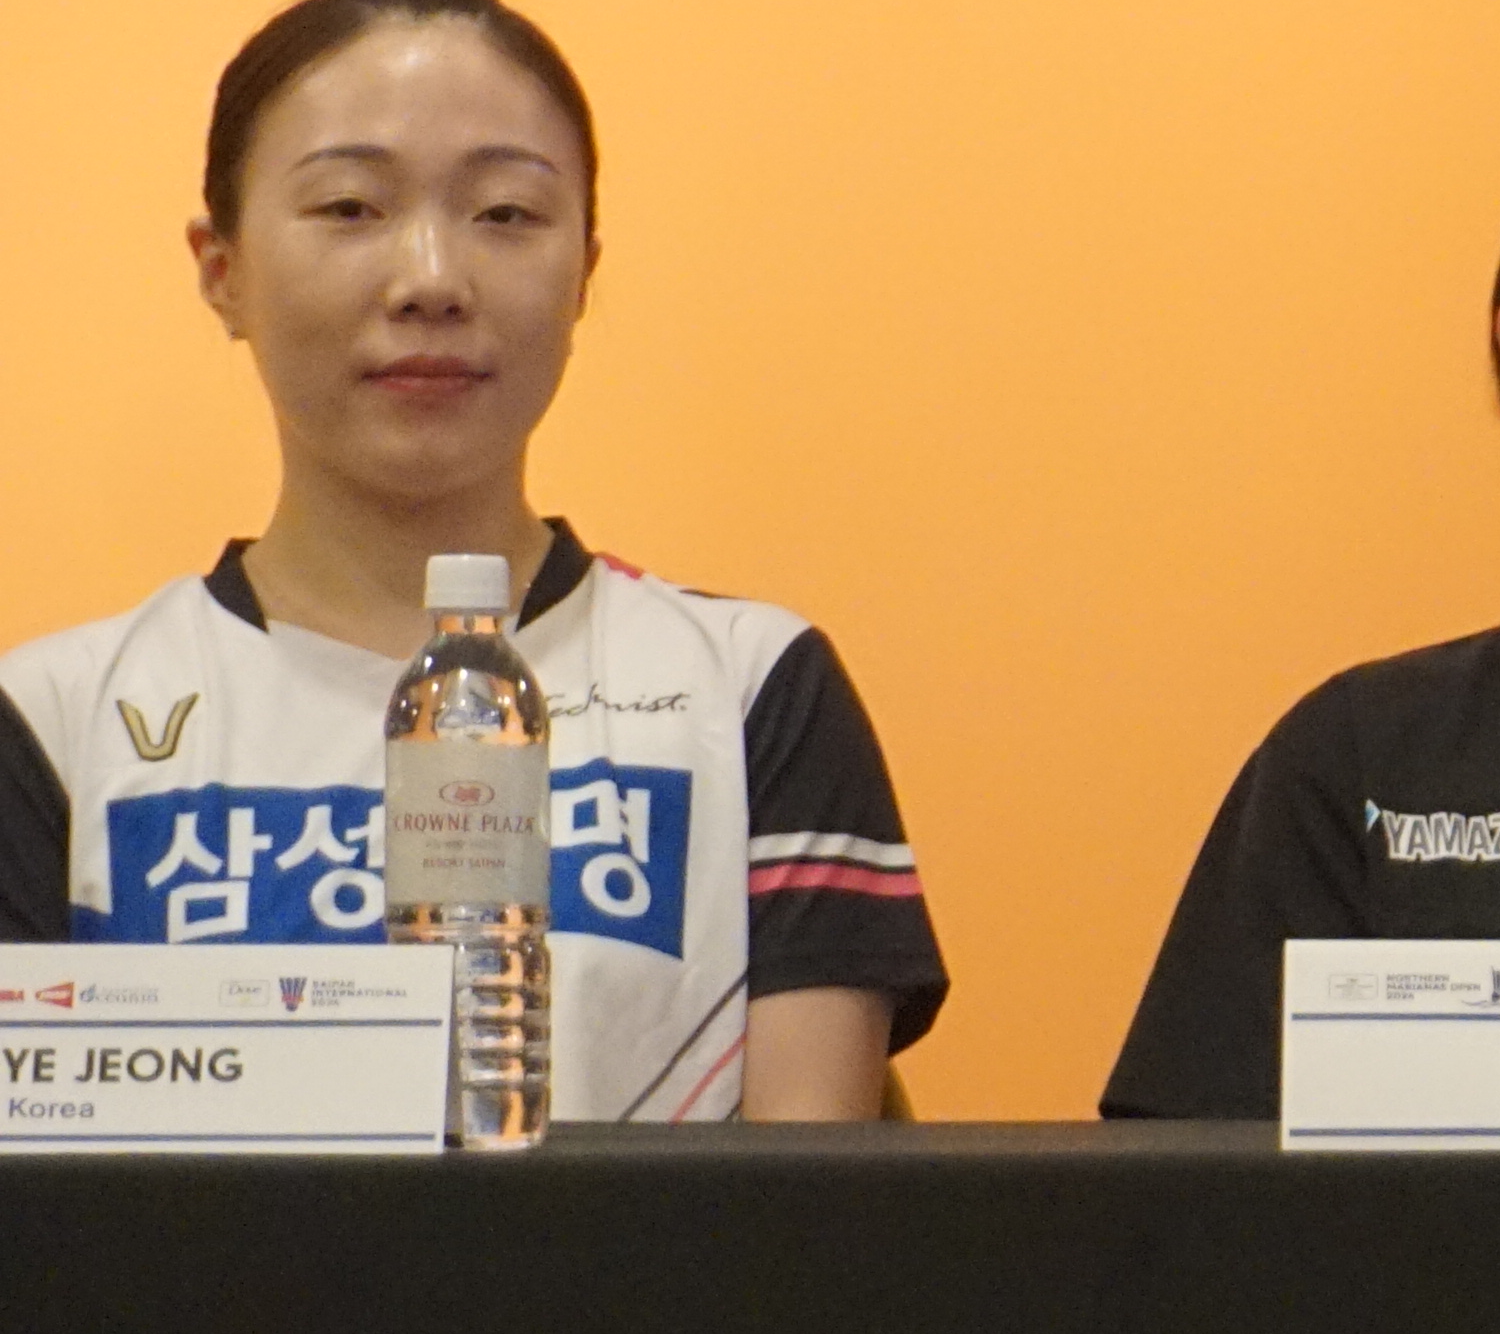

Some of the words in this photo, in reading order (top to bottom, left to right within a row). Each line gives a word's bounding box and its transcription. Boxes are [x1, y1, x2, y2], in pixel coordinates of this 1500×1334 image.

[145, 777, 654, 945] 삼성명
[74, 1046, 244, 1085] JEONG
[7, 1096, 96, 1119] Korea
